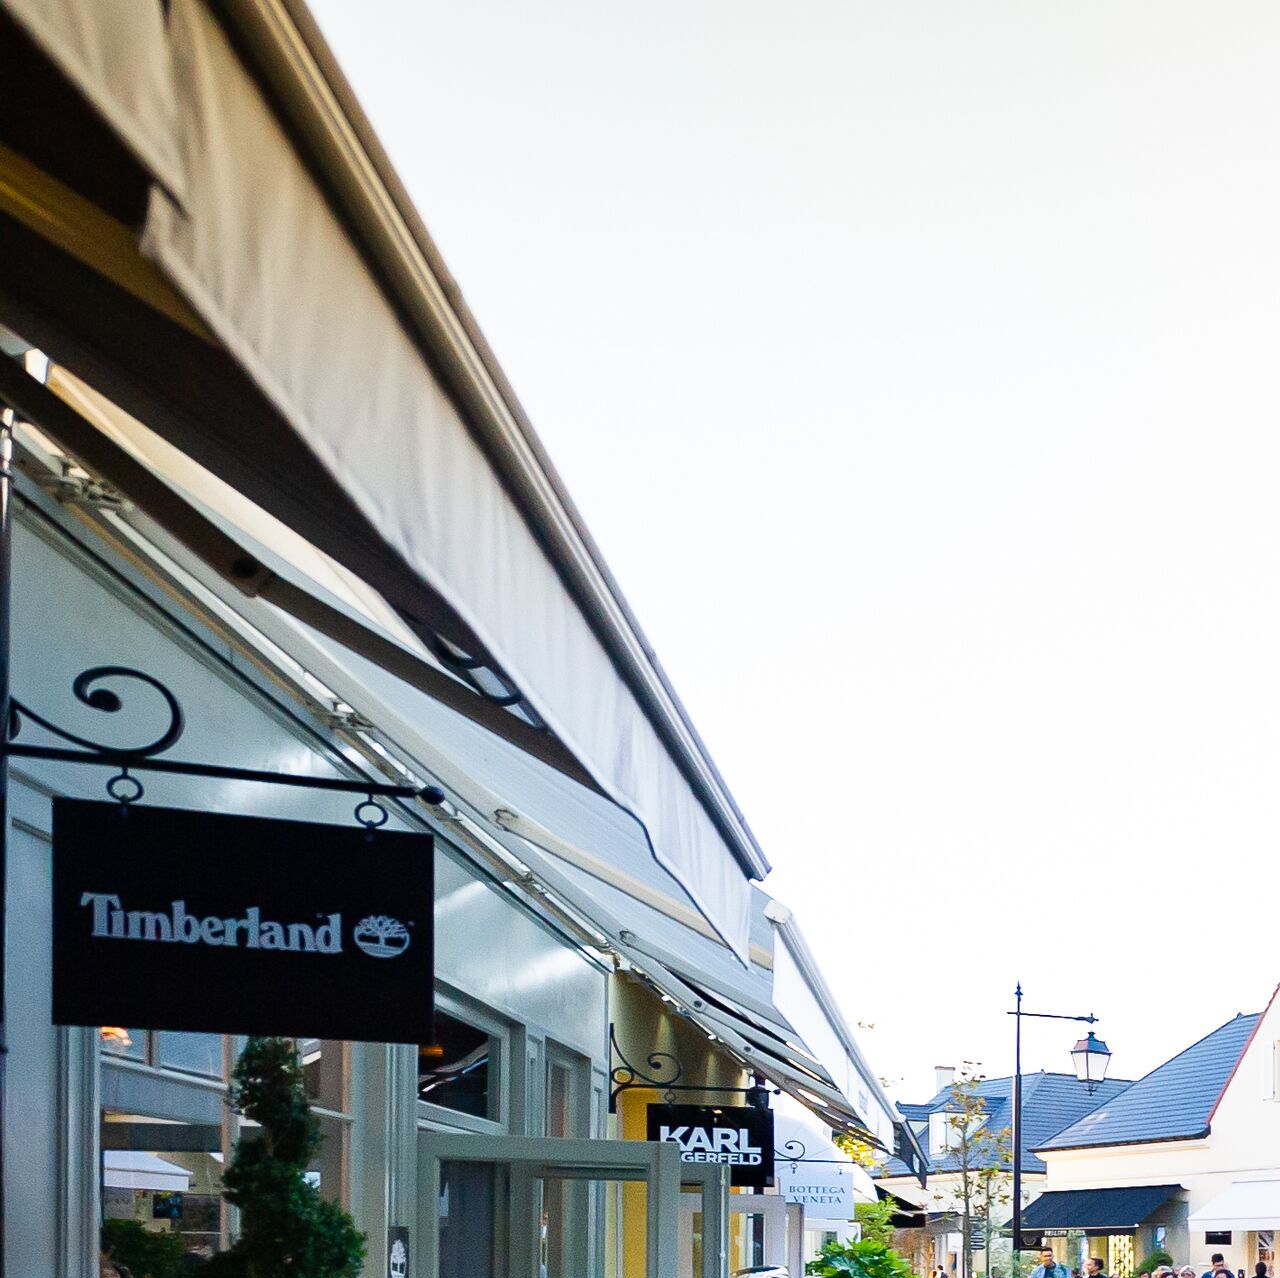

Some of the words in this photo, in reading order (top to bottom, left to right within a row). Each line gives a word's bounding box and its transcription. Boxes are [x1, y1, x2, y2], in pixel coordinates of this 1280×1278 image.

[80, 891, 343, 954] Timberland
[659, 1125, 762, 1154] KARL
[680, 1152, 763, 1166] GERFELD
[789, 1185, 846, 1194] BOTTEGA
[793, 1195, 842, 1204] VENETA
